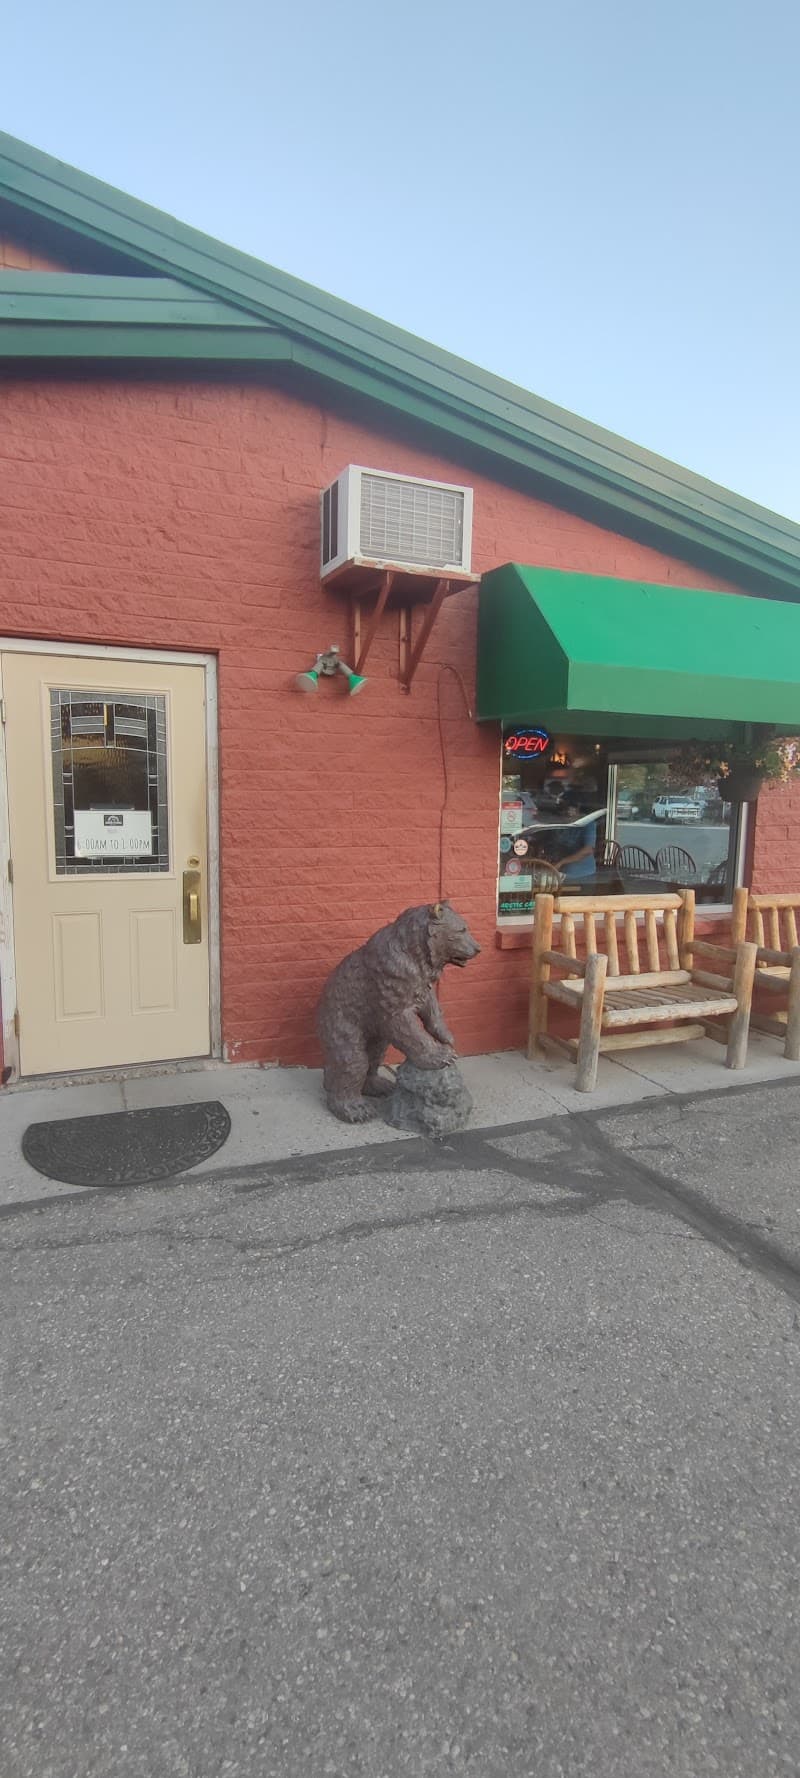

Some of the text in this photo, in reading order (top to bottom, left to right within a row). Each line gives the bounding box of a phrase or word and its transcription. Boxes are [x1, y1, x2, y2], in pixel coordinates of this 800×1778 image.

[505, 736, 549, 751] OPEN
[77, 838, 150, 850] 600AM TO 100PM
